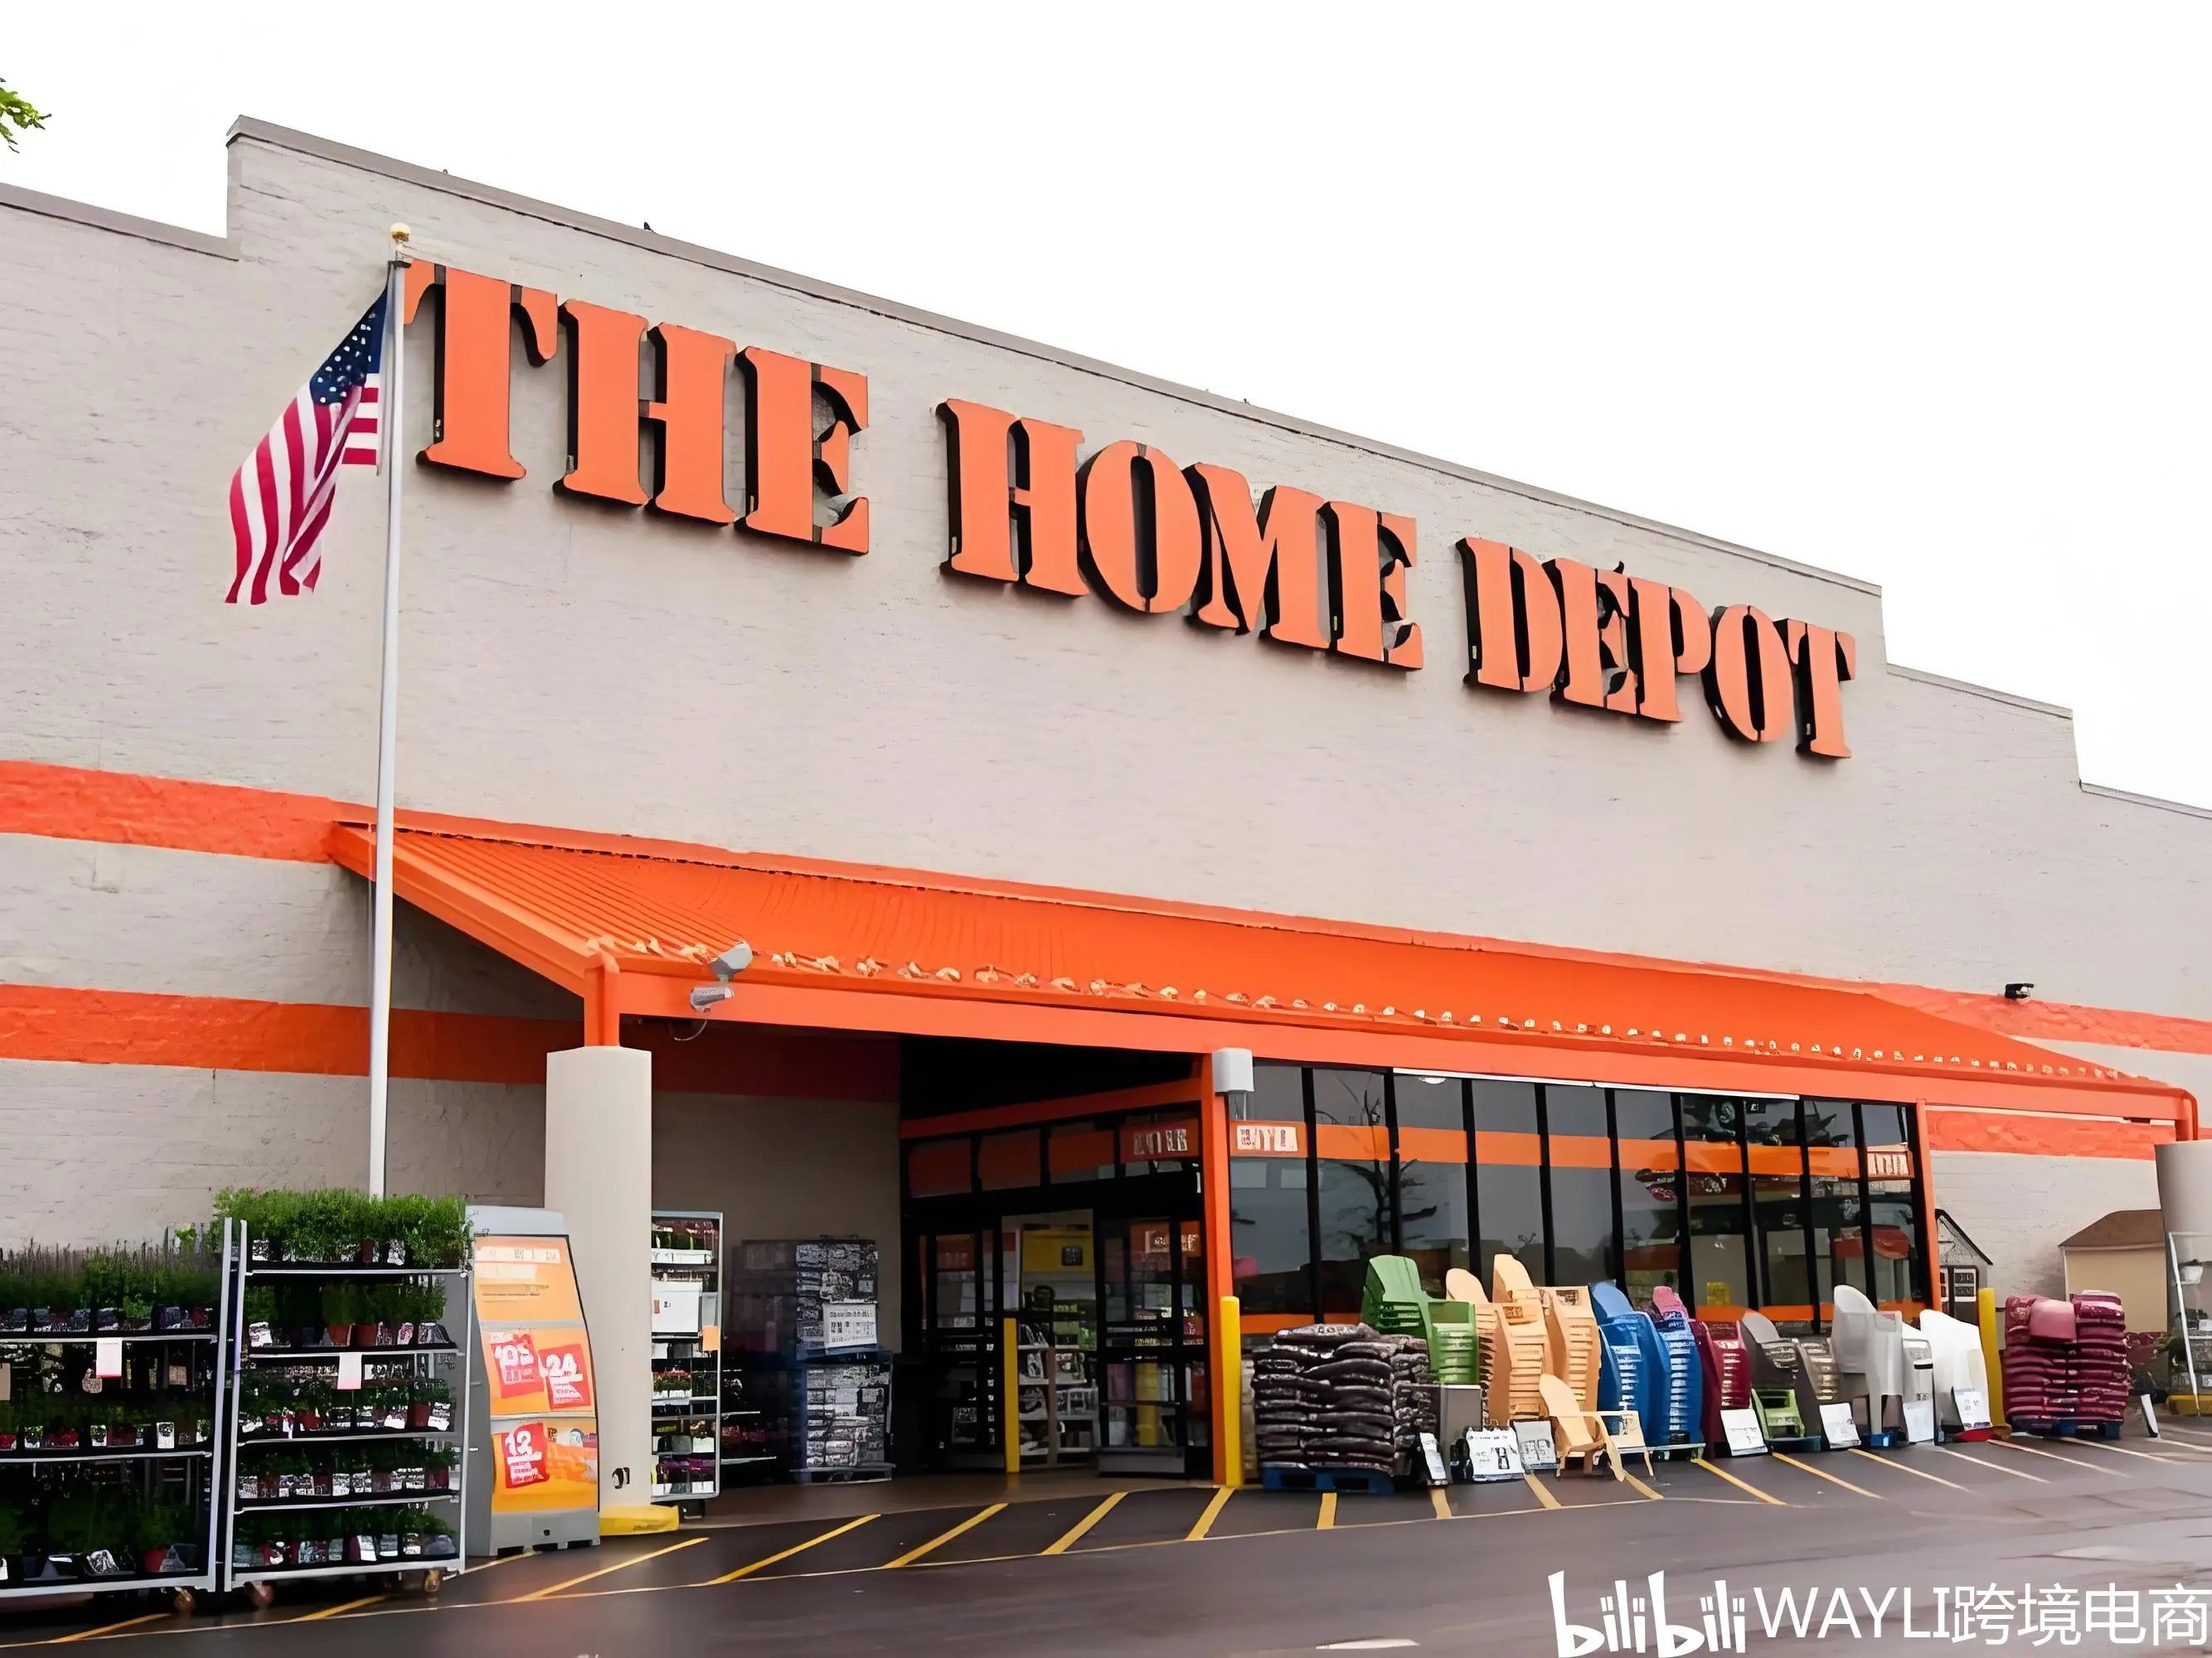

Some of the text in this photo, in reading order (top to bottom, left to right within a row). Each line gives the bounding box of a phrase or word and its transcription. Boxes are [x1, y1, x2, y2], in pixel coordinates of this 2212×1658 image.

[404, 258, 1857, 759] THE HOME DEPOT
